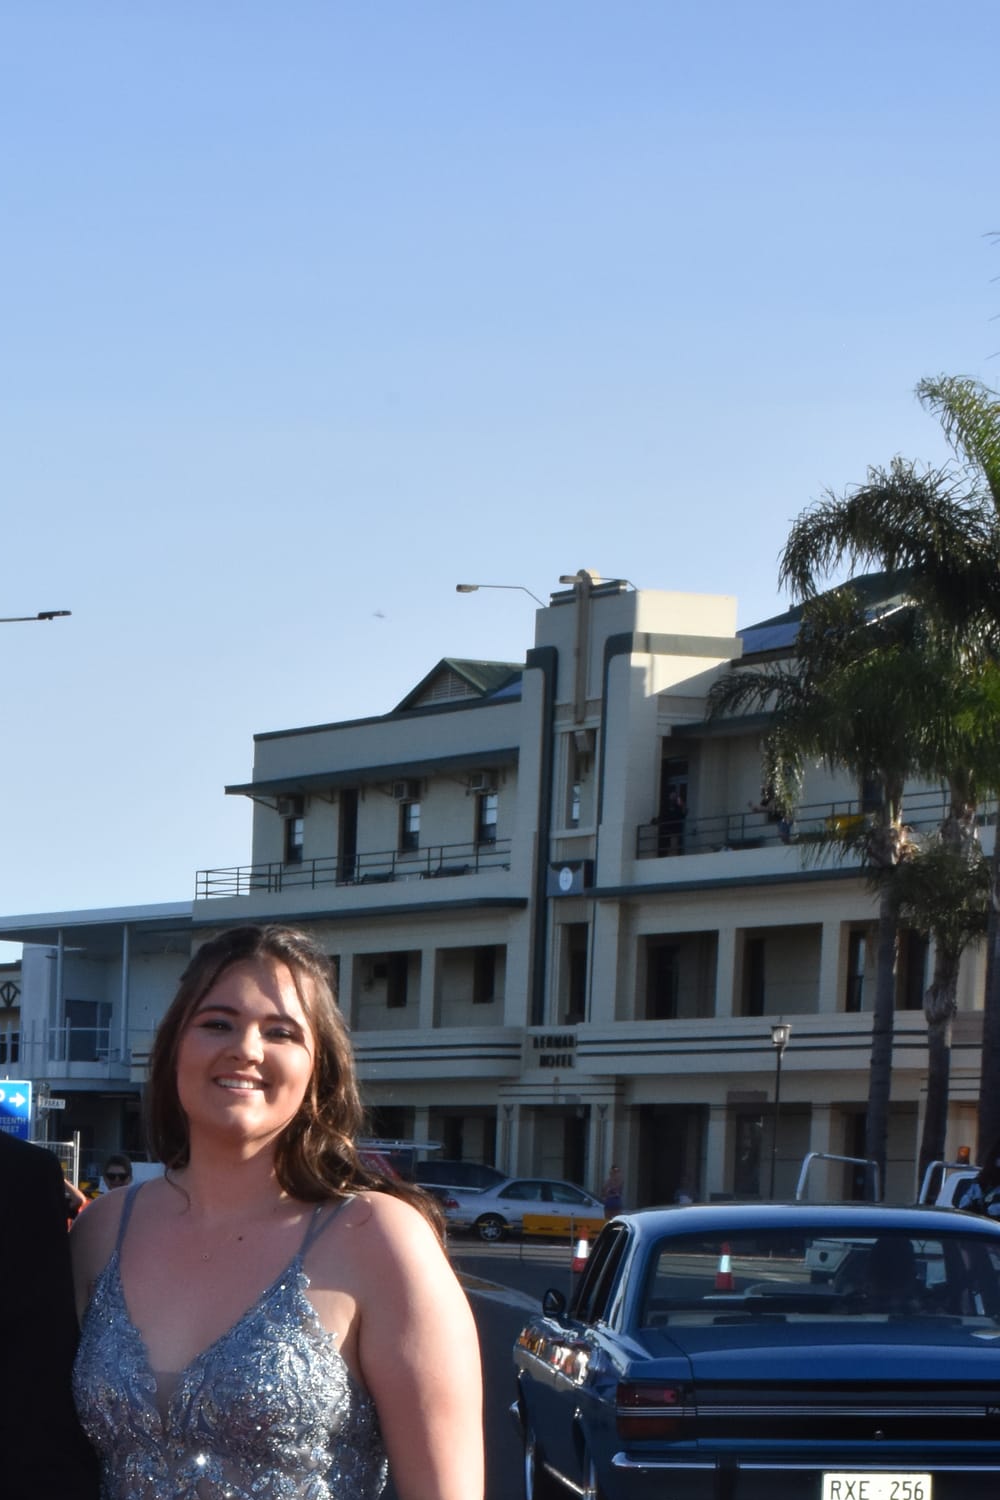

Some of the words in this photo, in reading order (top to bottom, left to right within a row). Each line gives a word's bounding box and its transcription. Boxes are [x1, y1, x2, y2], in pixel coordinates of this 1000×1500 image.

[539, 1054, 575, 1069] HOTEL
[830, 1480, 870, 1500] RXE
[889, 1480, 924, 1500] 256
